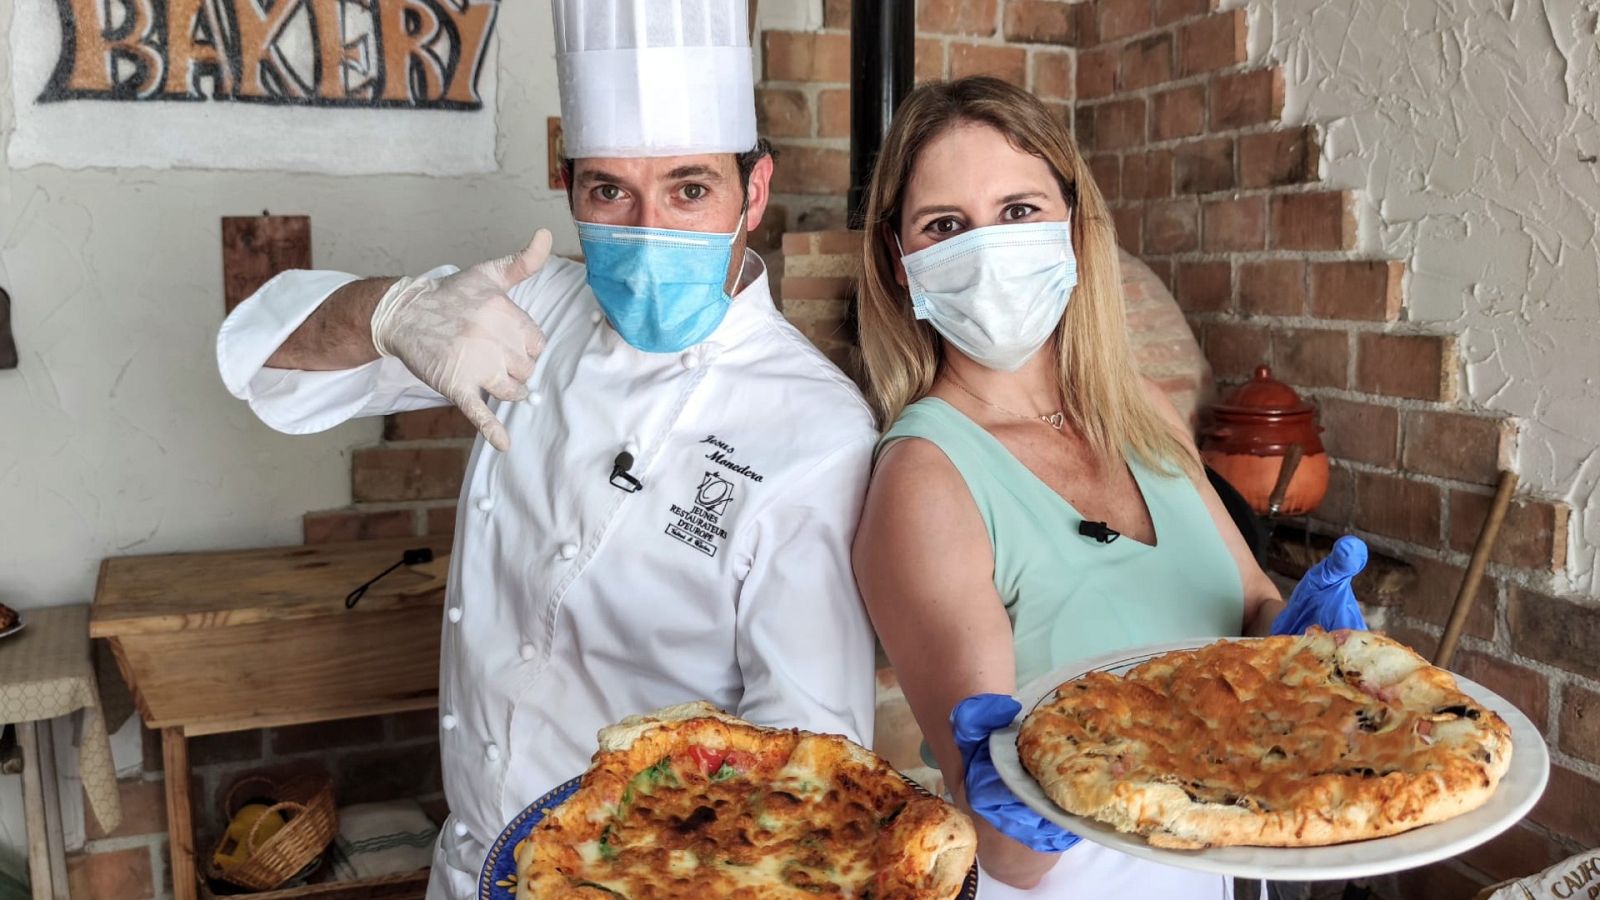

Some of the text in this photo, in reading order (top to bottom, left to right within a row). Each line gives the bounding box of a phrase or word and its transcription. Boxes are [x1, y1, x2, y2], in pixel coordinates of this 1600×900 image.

[36, 0, 499, 110] BAKERY
[699, 434, 735, 454] Jesus
[705, 450, 763, 483] Monedero
[669, 504, 728, 539] RESTAURATEURS
[690, 505, 718, 524] JEUNES
[677, 519, 714, 542] D'EUROPE
